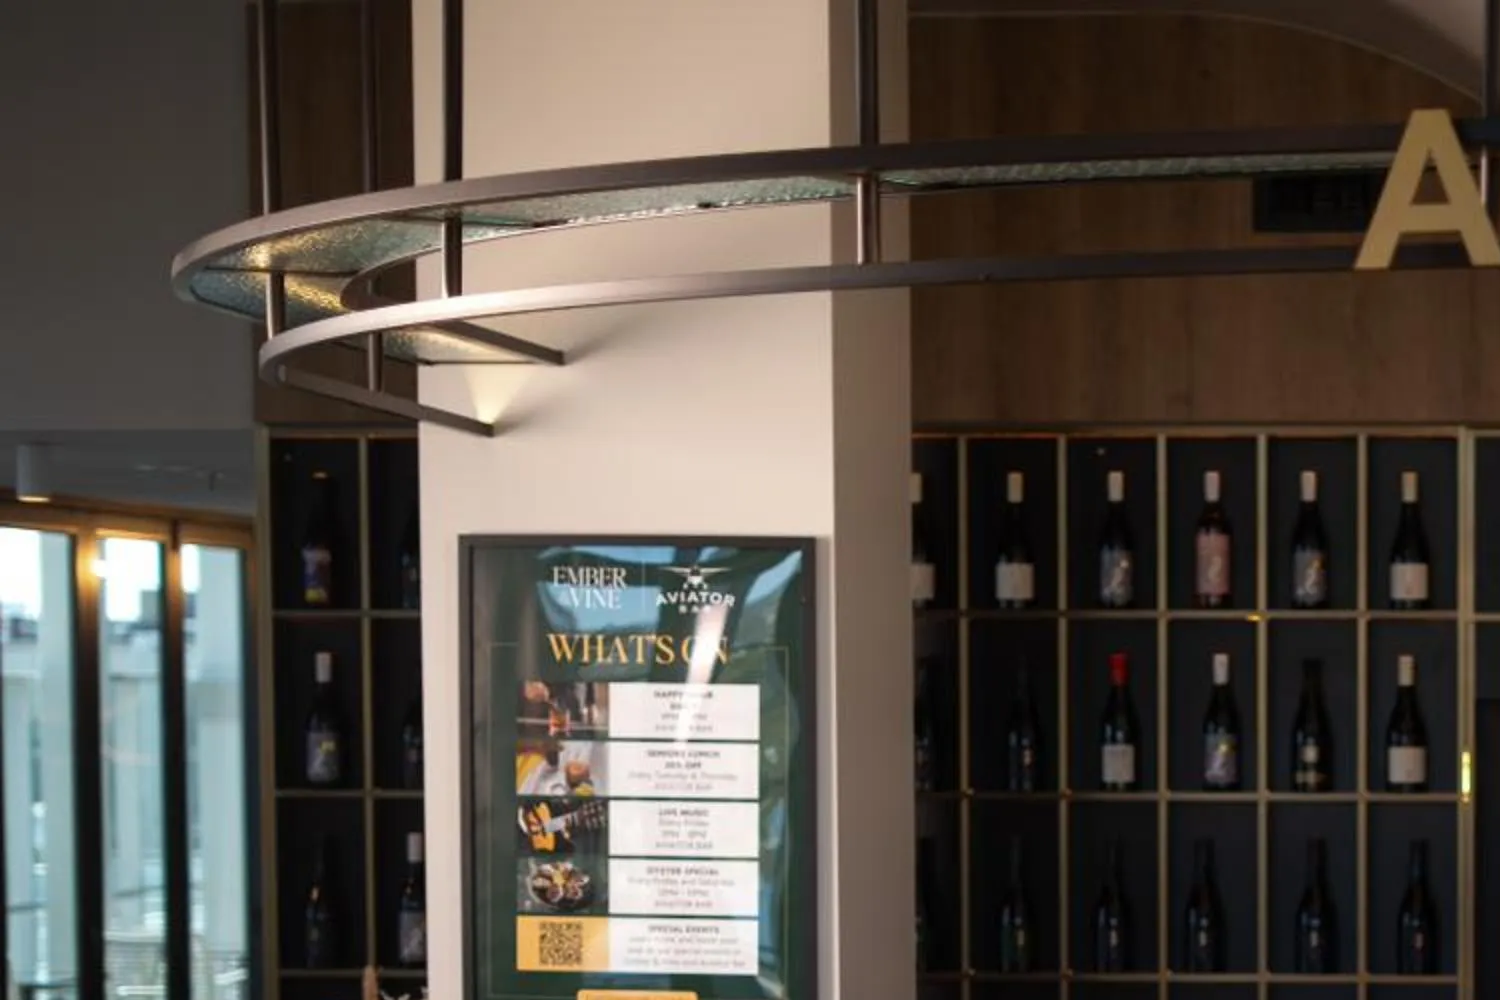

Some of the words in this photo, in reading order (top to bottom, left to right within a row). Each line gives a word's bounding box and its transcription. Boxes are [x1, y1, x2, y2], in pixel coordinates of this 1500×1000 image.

[553, 565, 627, 590] EMBER
[655, 591, 736, 608] AVIATOR
[546, 632, 676, 666] WHAT'S
